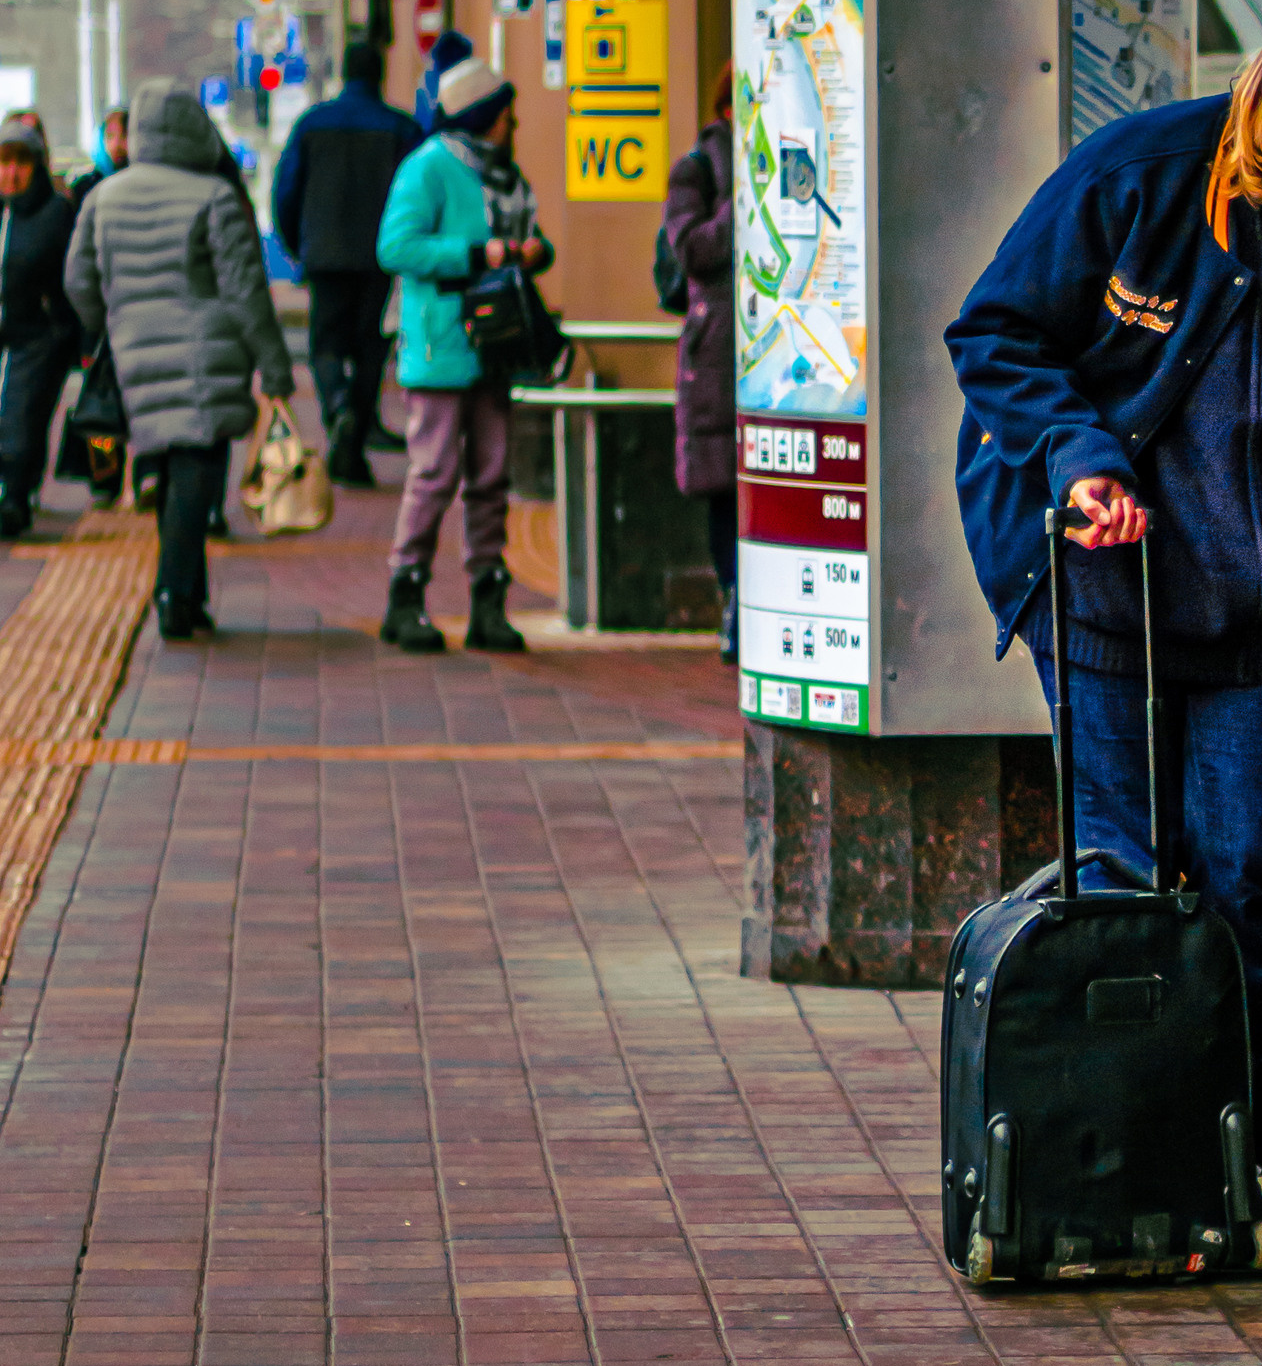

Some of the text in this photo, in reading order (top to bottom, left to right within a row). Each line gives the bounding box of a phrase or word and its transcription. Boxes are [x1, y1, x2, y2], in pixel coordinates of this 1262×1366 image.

[577, 137, 645, 180] WC
[822, 434, 848, 461] 300
[822, 494, 848, 521] 800
[825, 562, 847, 584] 150
[825, 627, 847, 649] 500
